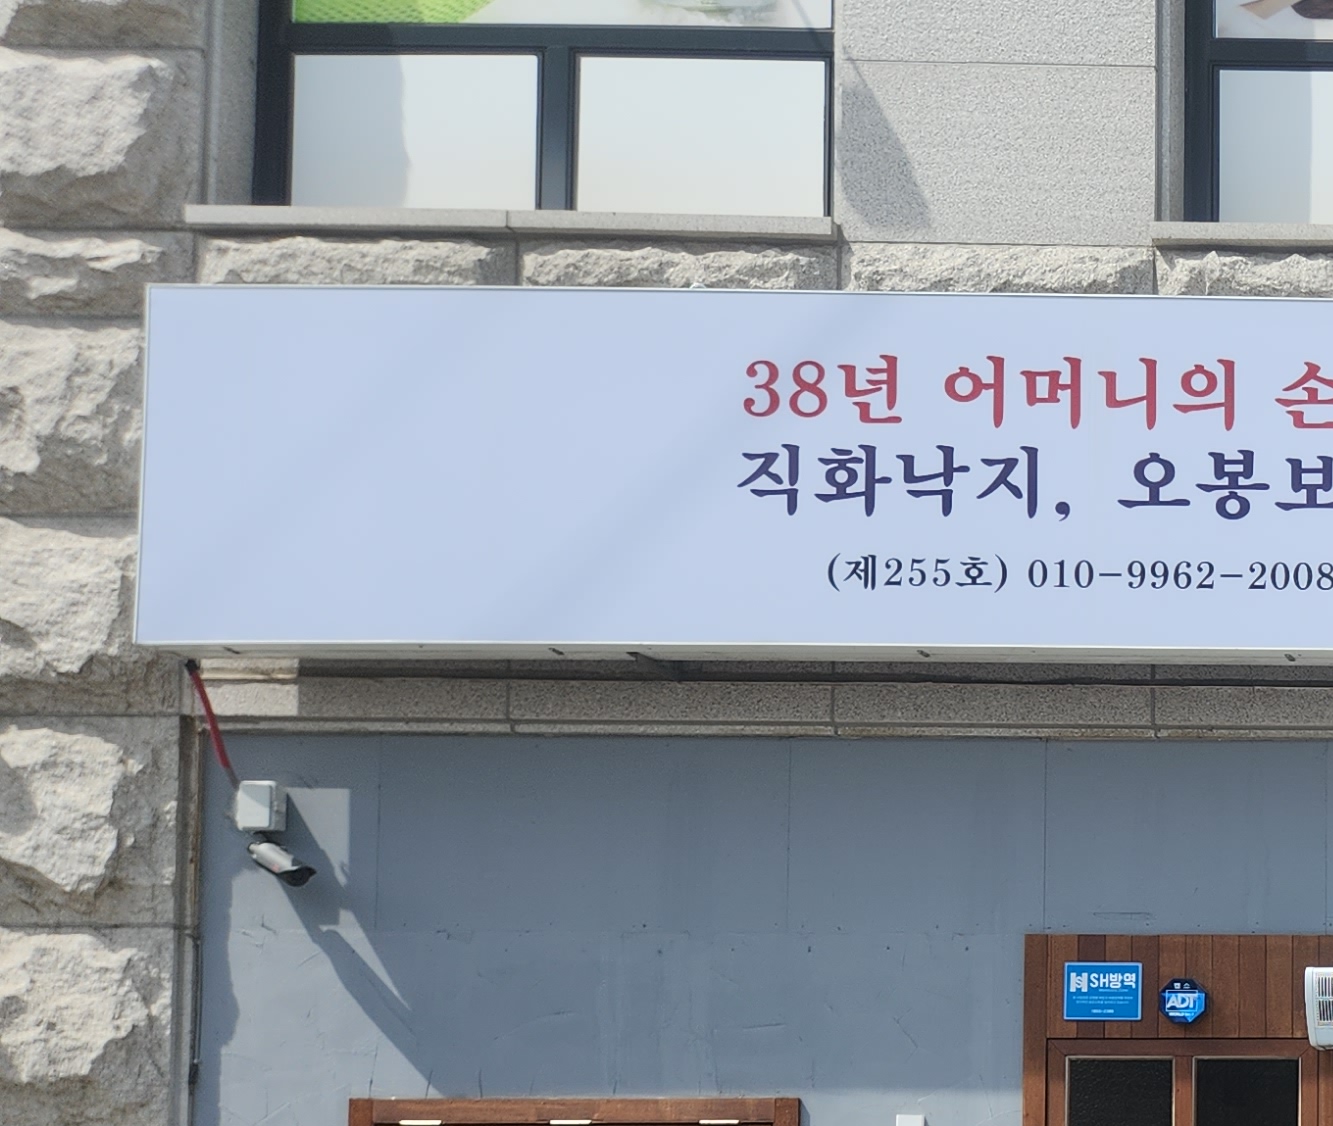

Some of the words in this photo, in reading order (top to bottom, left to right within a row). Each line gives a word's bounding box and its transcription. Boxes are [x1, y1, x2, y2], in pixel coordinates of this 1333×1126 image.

[742, 354, 904, 425] 38년
[943, 355, 1236, 431] 어머니의
[737, 443, 1072, 522] 직화낙지,
[826, 553, 1009, 592] (제255호)
[1090, 972, 1136, 989] SH방역
[1167, 993, 1197, 1009] ADT
